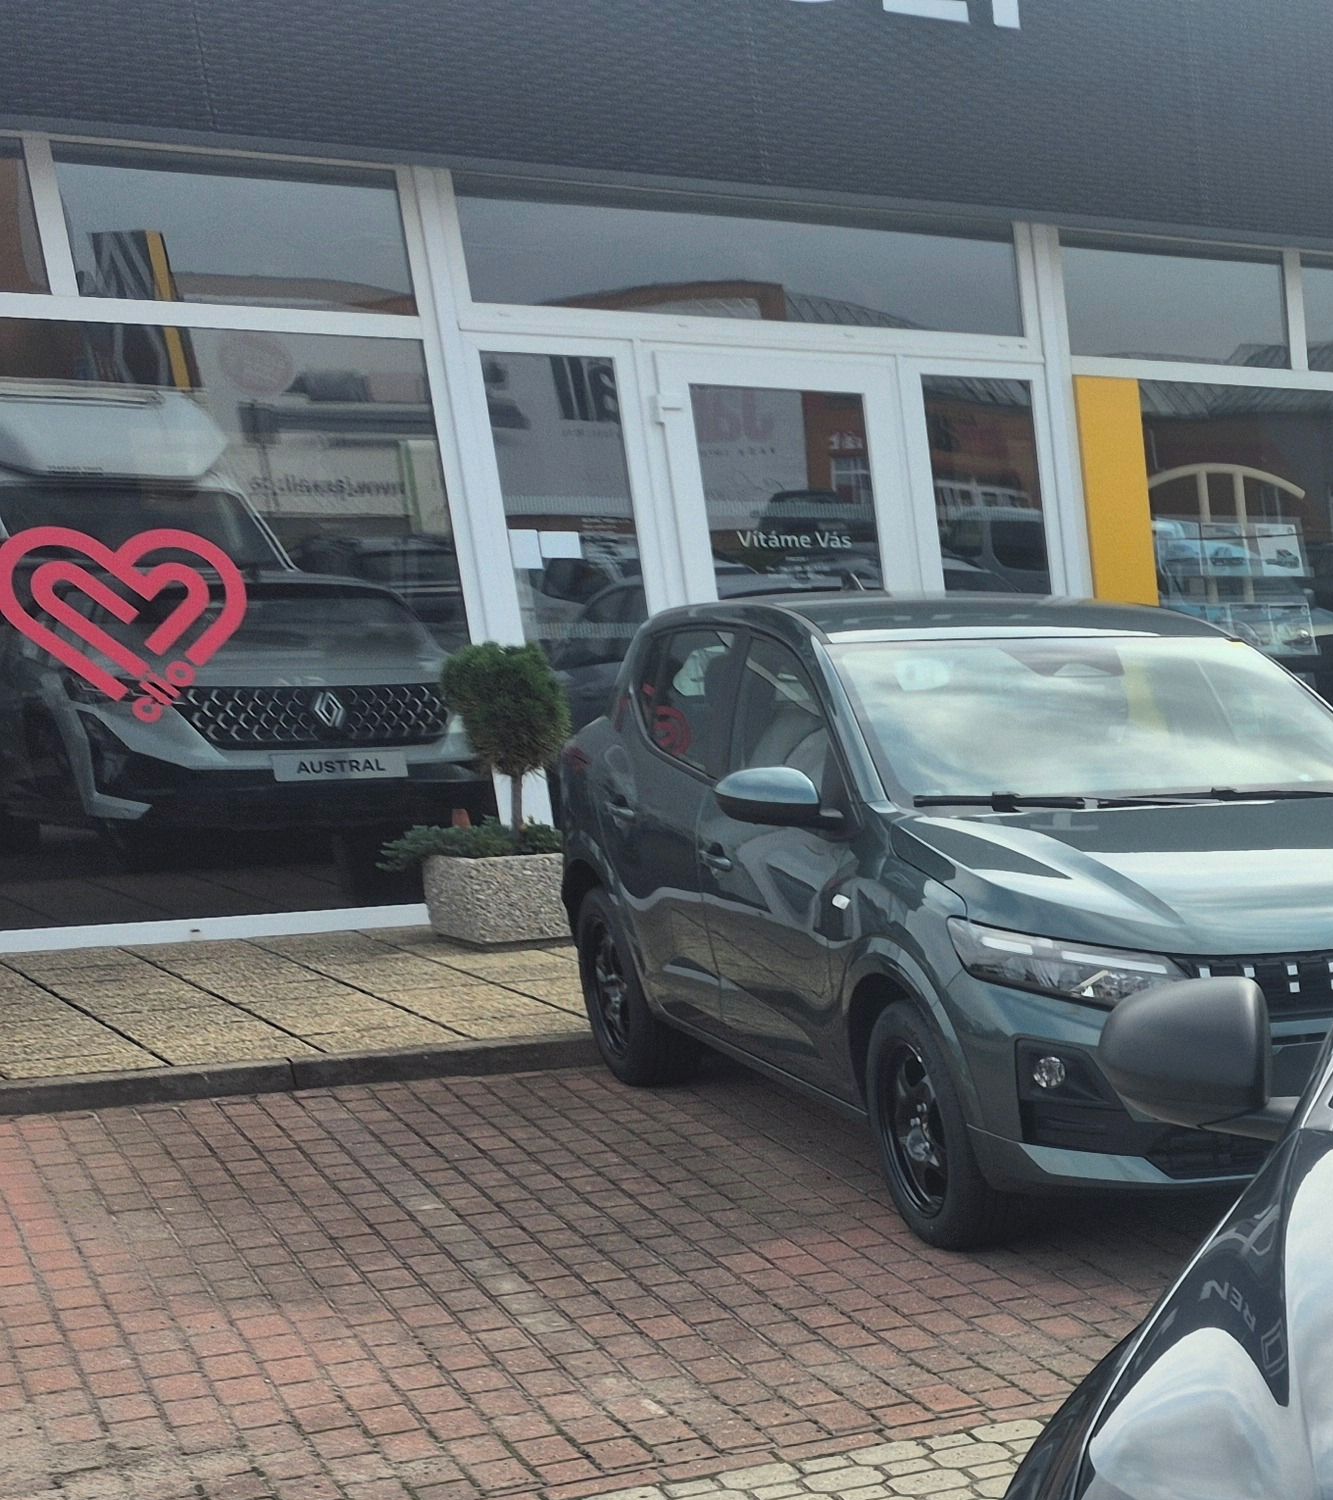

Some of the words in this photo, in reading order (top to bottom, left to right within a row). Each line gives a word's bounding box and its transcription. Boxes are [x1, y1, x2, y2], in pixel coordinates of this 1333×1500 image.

[736, 529, 813, 548] Vítáme
[815, 530, 852, 549] Vás
[297, 758, 386, 775] AUSTRAL
